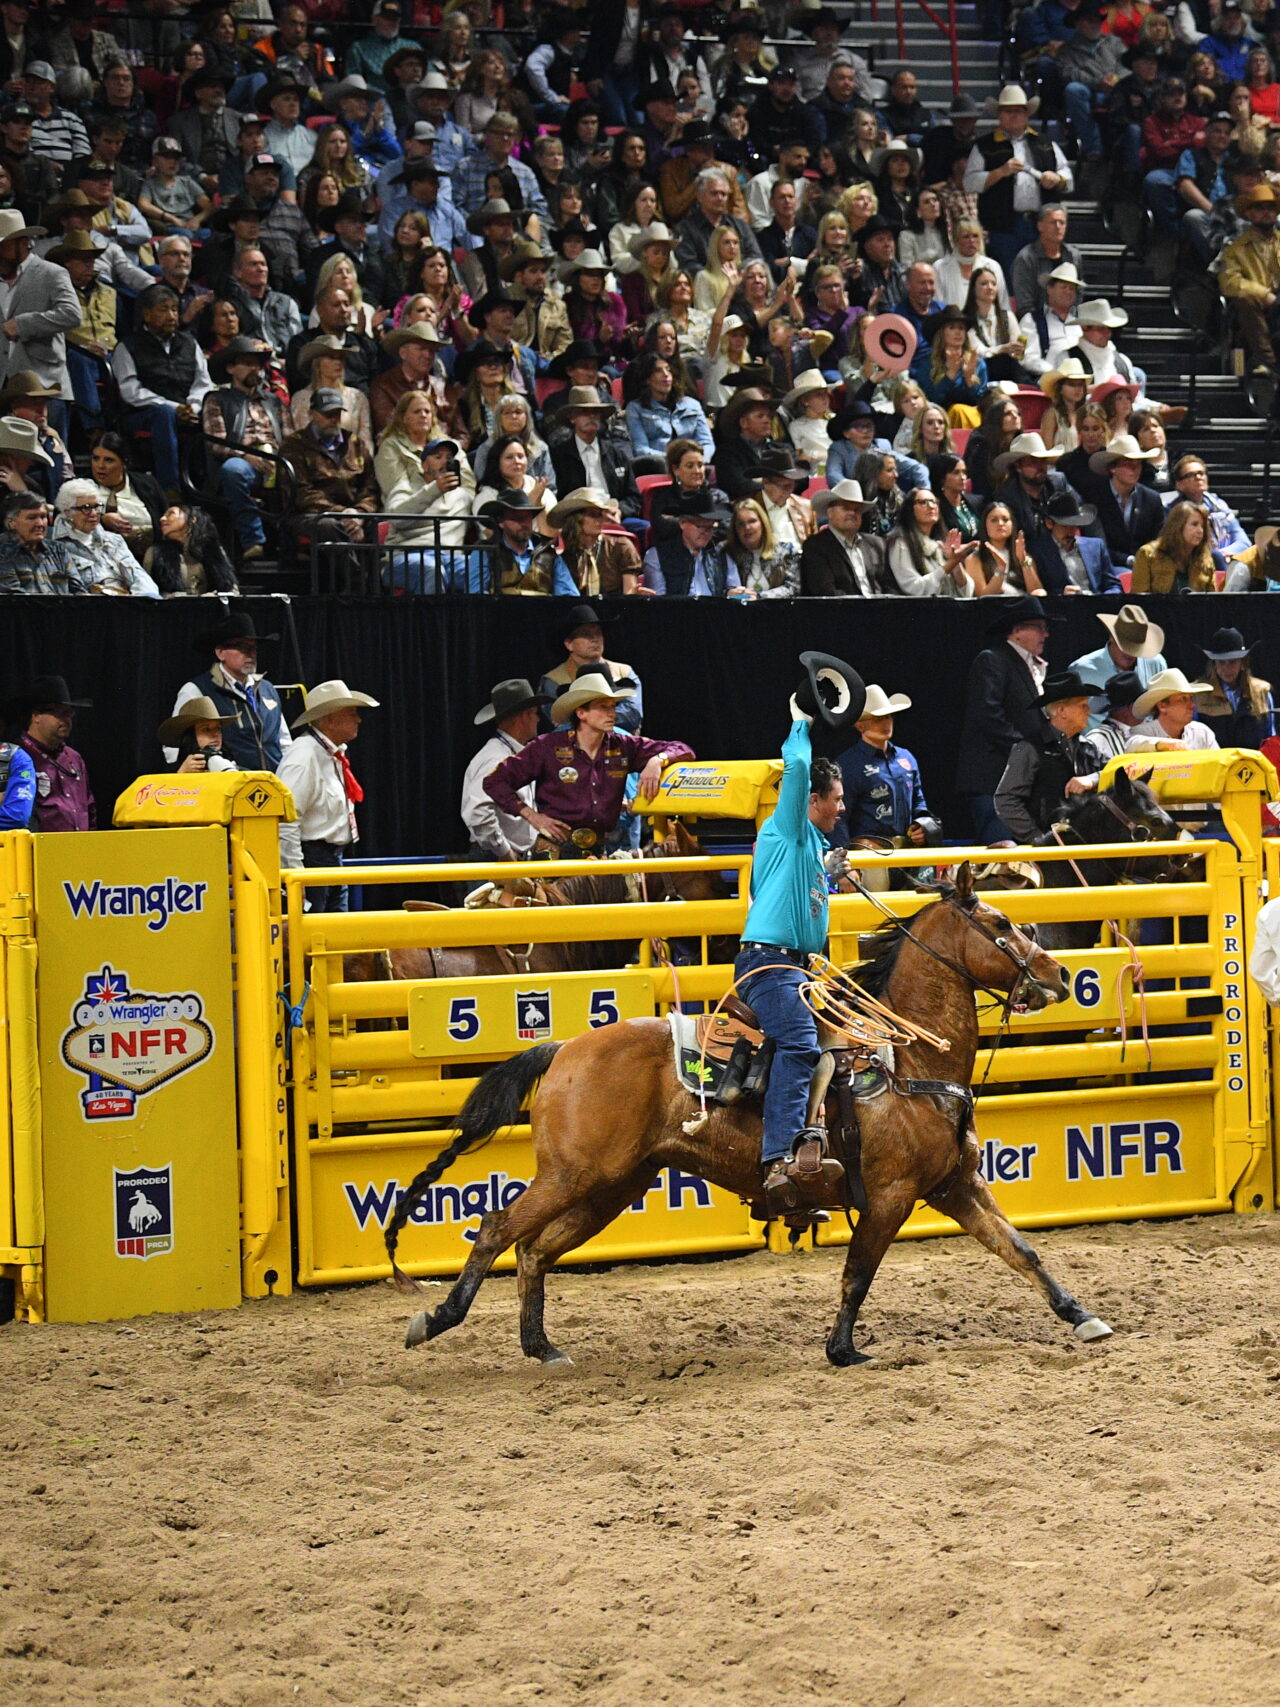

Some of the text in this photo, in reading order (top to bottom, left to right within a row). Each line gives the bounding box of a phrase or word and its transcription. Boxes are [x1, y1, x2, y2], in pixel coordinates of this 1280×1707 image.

[63, 878, 206, 930] Wrangler
[1074, 969, 1101, 1007] 6
[83, 1011, 89, 1019] 2
[110, 1004, 166, 1025] Wrangler
[173, 1006, 178, 1014] 2
[188, 1005, 193, 1013] 5
[448, 990, 619, 1040] 5 5
[111, 1028, 187, 1059] NFR
[1066, 1121, 1182, 1180] NFR
[117, 1177, 168, 1188] PRORODEO
[345, 1173, 535, 1242] Wangle
[147, 1241, 169, 1249] PRCA
